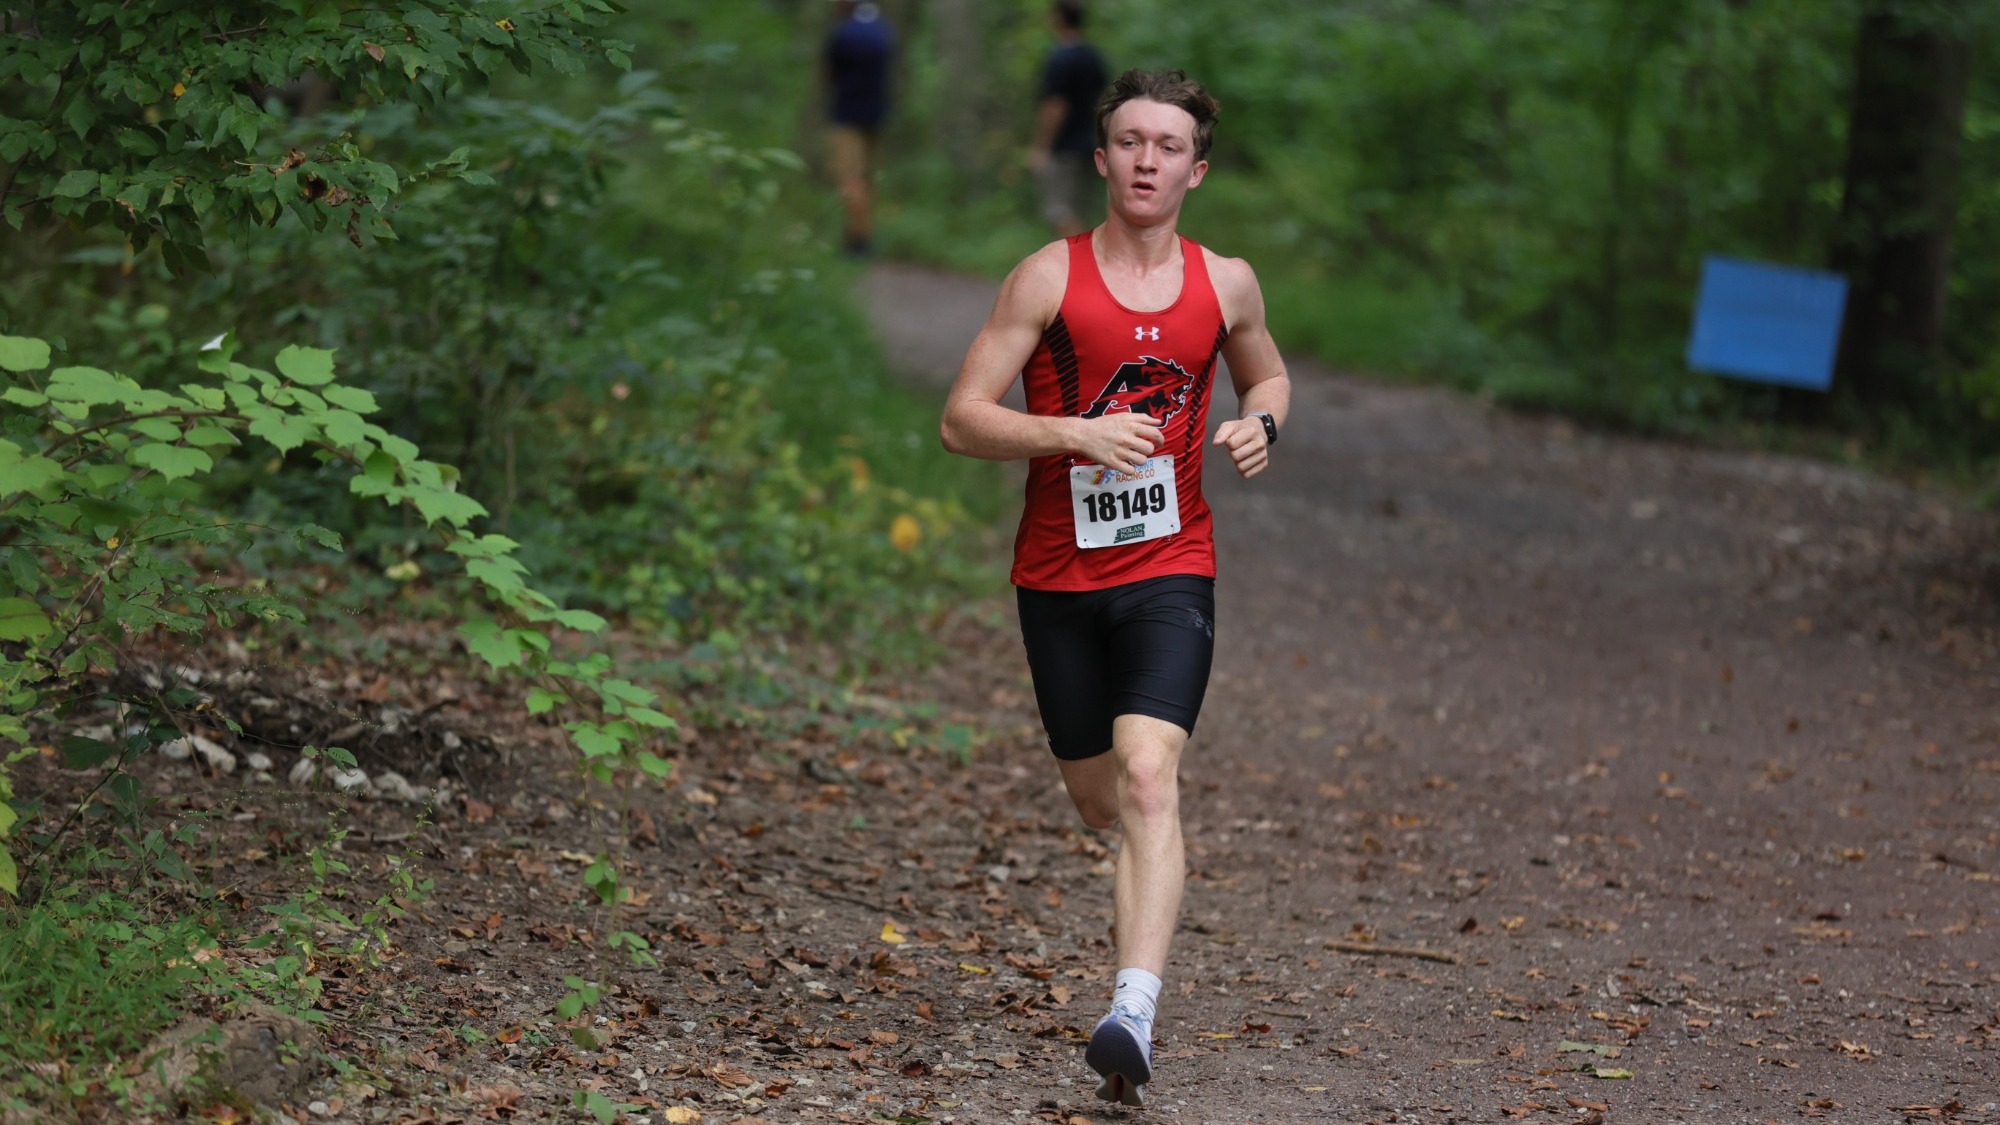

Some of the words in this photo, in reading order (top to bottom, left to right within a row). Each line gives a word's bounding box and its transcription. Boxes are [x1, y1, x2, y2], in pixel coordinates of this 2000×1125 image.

[1116, 470, 1143, 483] RACING
[1144, 468, 1155, 478] CO
[1083, 483, 1166, 522] 18149
[1120, 525, 1143, 534] NOLAN
[1120, 531, 1144, 539] Painting
